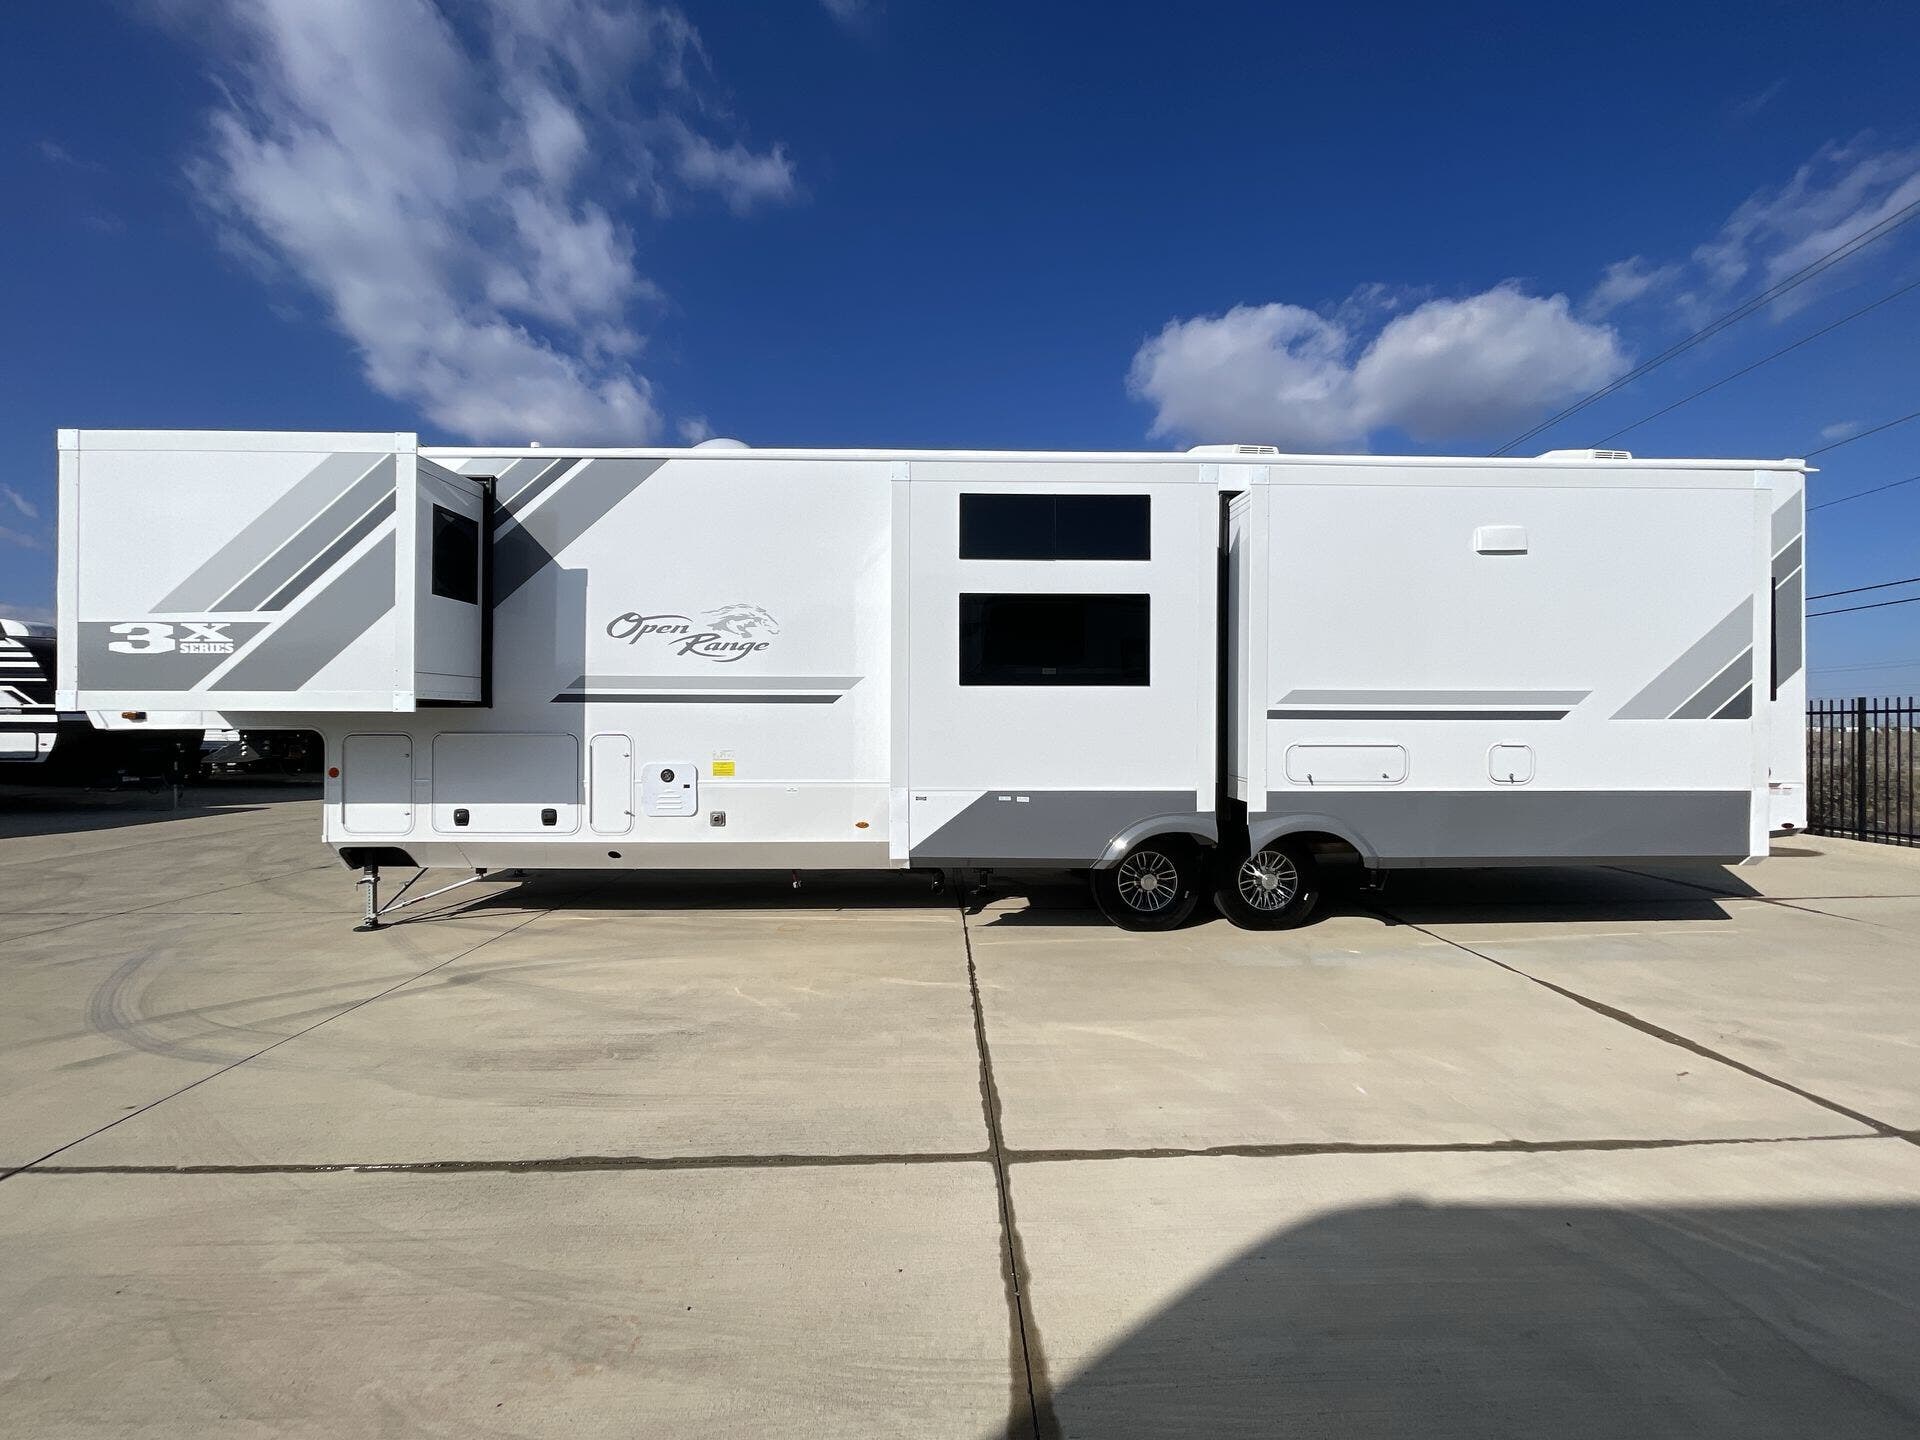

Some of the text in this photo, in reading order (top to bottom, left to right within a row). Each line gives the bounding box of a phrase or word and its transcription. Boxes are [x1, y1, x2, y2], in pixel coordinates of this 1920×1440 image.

[606, 612, 693, 645] Open
[180, 643, 234, 654] SERIES
[668, 633, 769, 662] Range
